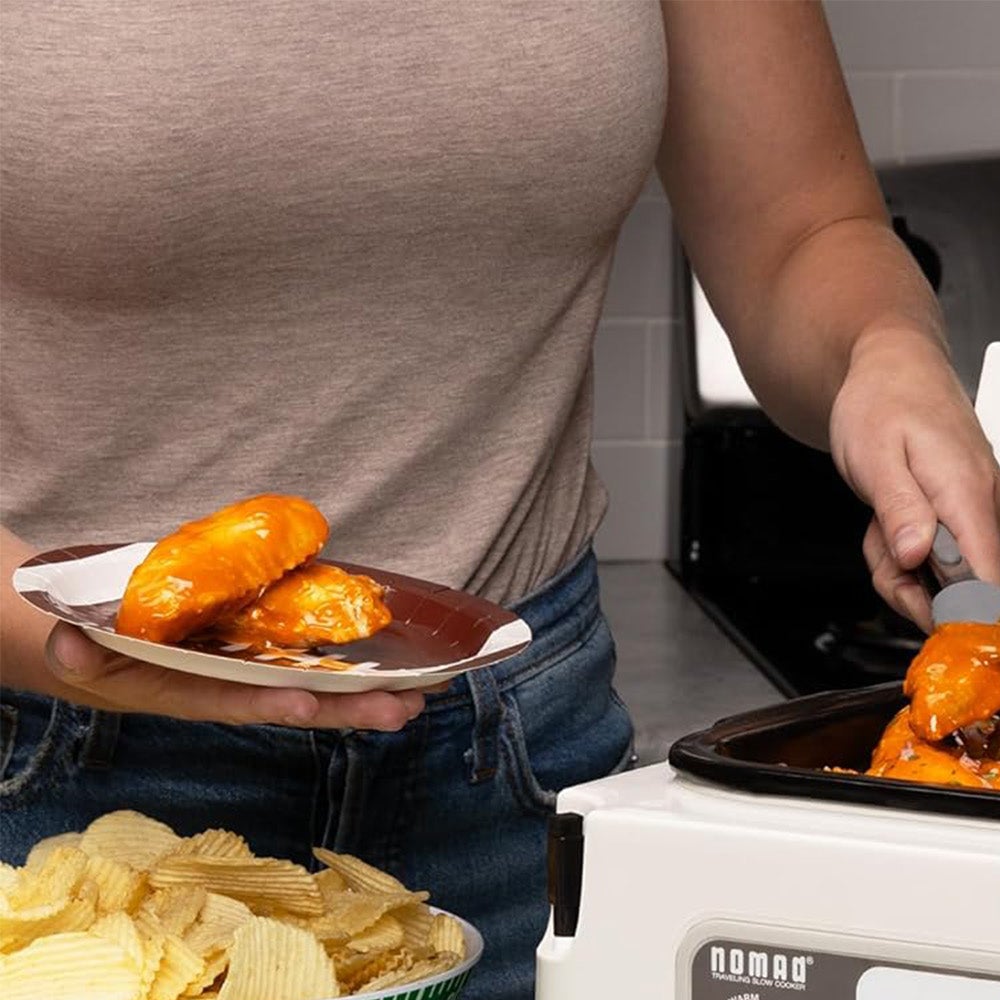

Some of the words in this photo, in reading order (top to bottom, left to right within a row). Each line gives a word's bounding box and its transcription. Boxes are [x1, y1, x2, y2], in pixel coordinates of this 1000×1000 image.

[711, 972, 750, 985] TRAVELING
[751, 977, 774, 987] SLOW
[774, 980, 806, 991] COOKER
